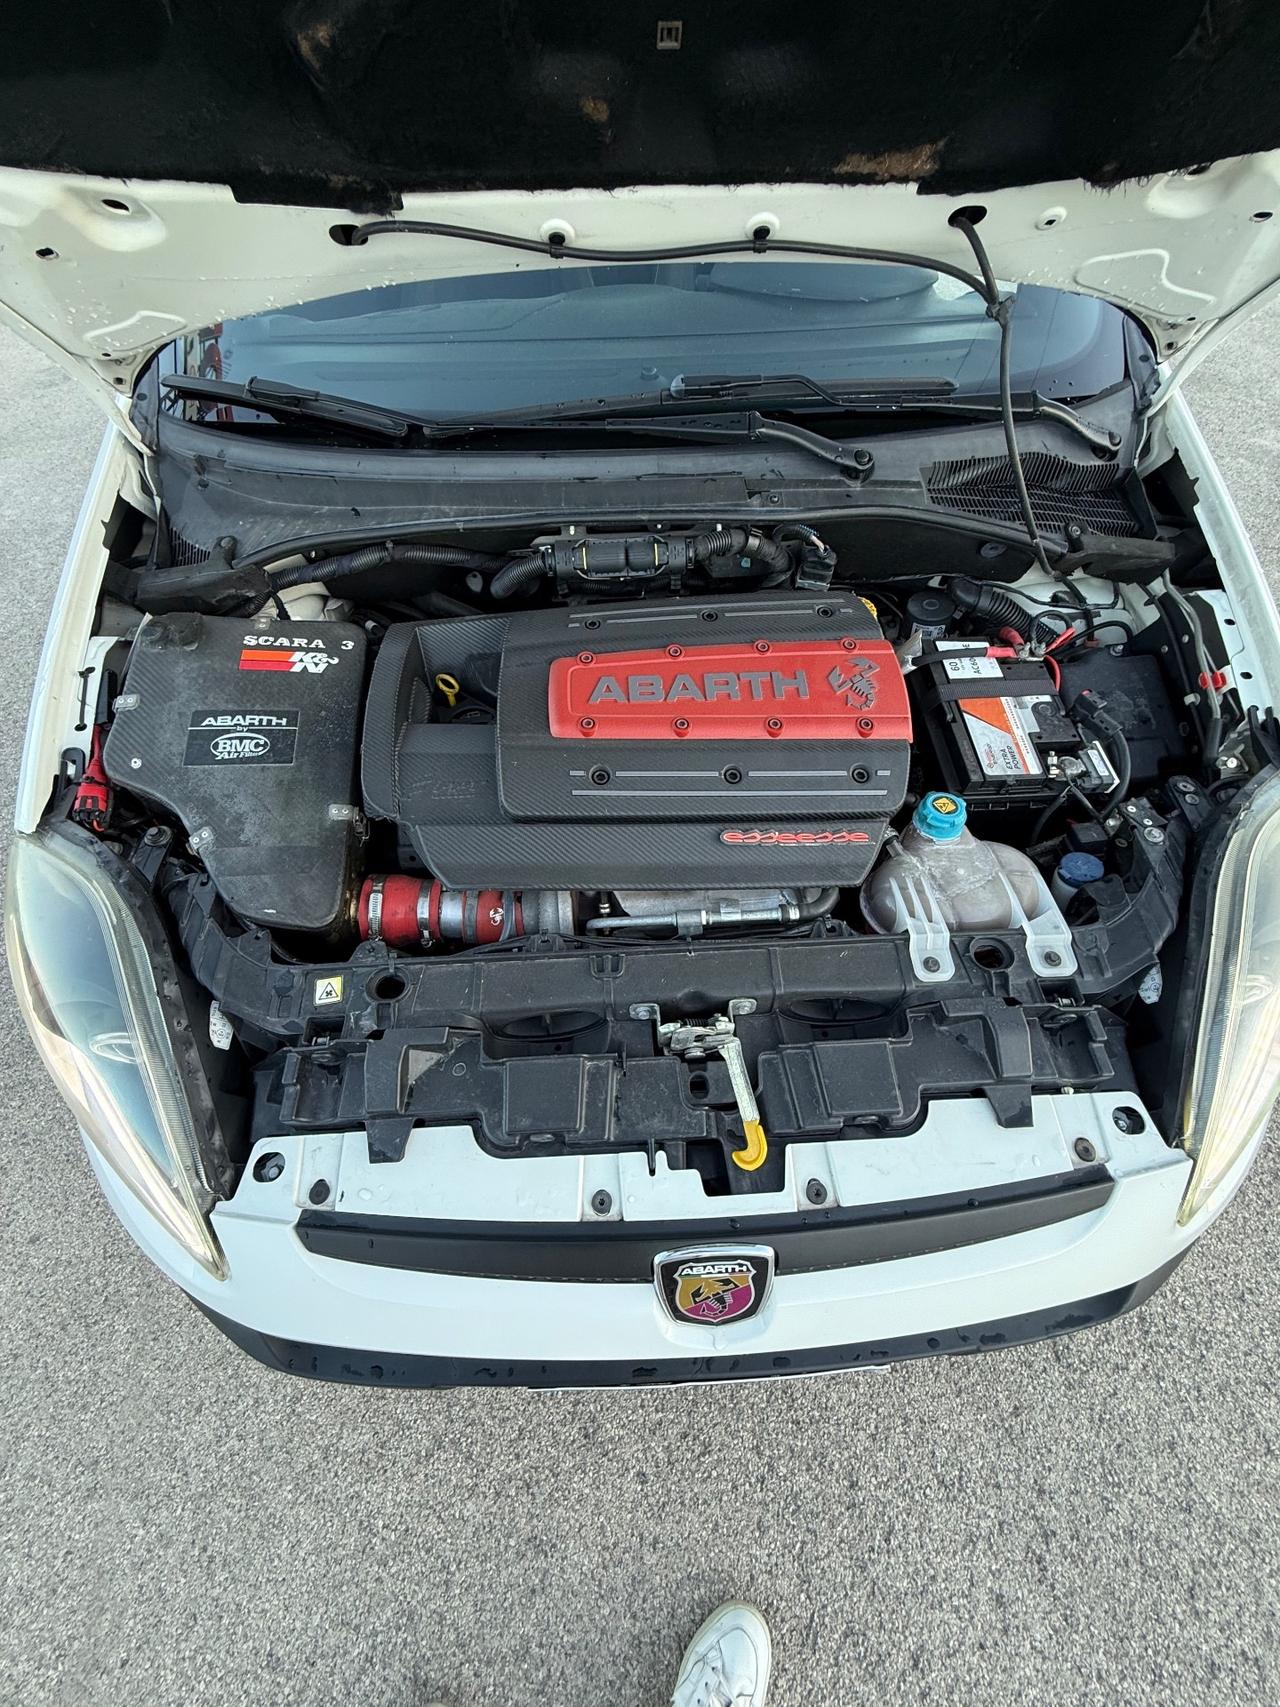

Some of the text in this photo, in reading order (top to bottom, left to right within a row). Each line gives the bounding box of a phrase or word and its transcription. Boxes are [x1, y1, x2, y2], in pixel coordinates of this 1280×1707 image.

[243, 635, 355, 650] SCARA 3
[587, 671, 809, 704] ABARTH
[201, 715, 288, 726] ABARTH
[216, 739, 265, 752] BMC
[215, 751, 240, 760] Air
[1000, 748, 1013, 769] EXTRA
[1007, 745, 1021, 770] POWER
[681, 1265, 747, 1275] ABARTH
